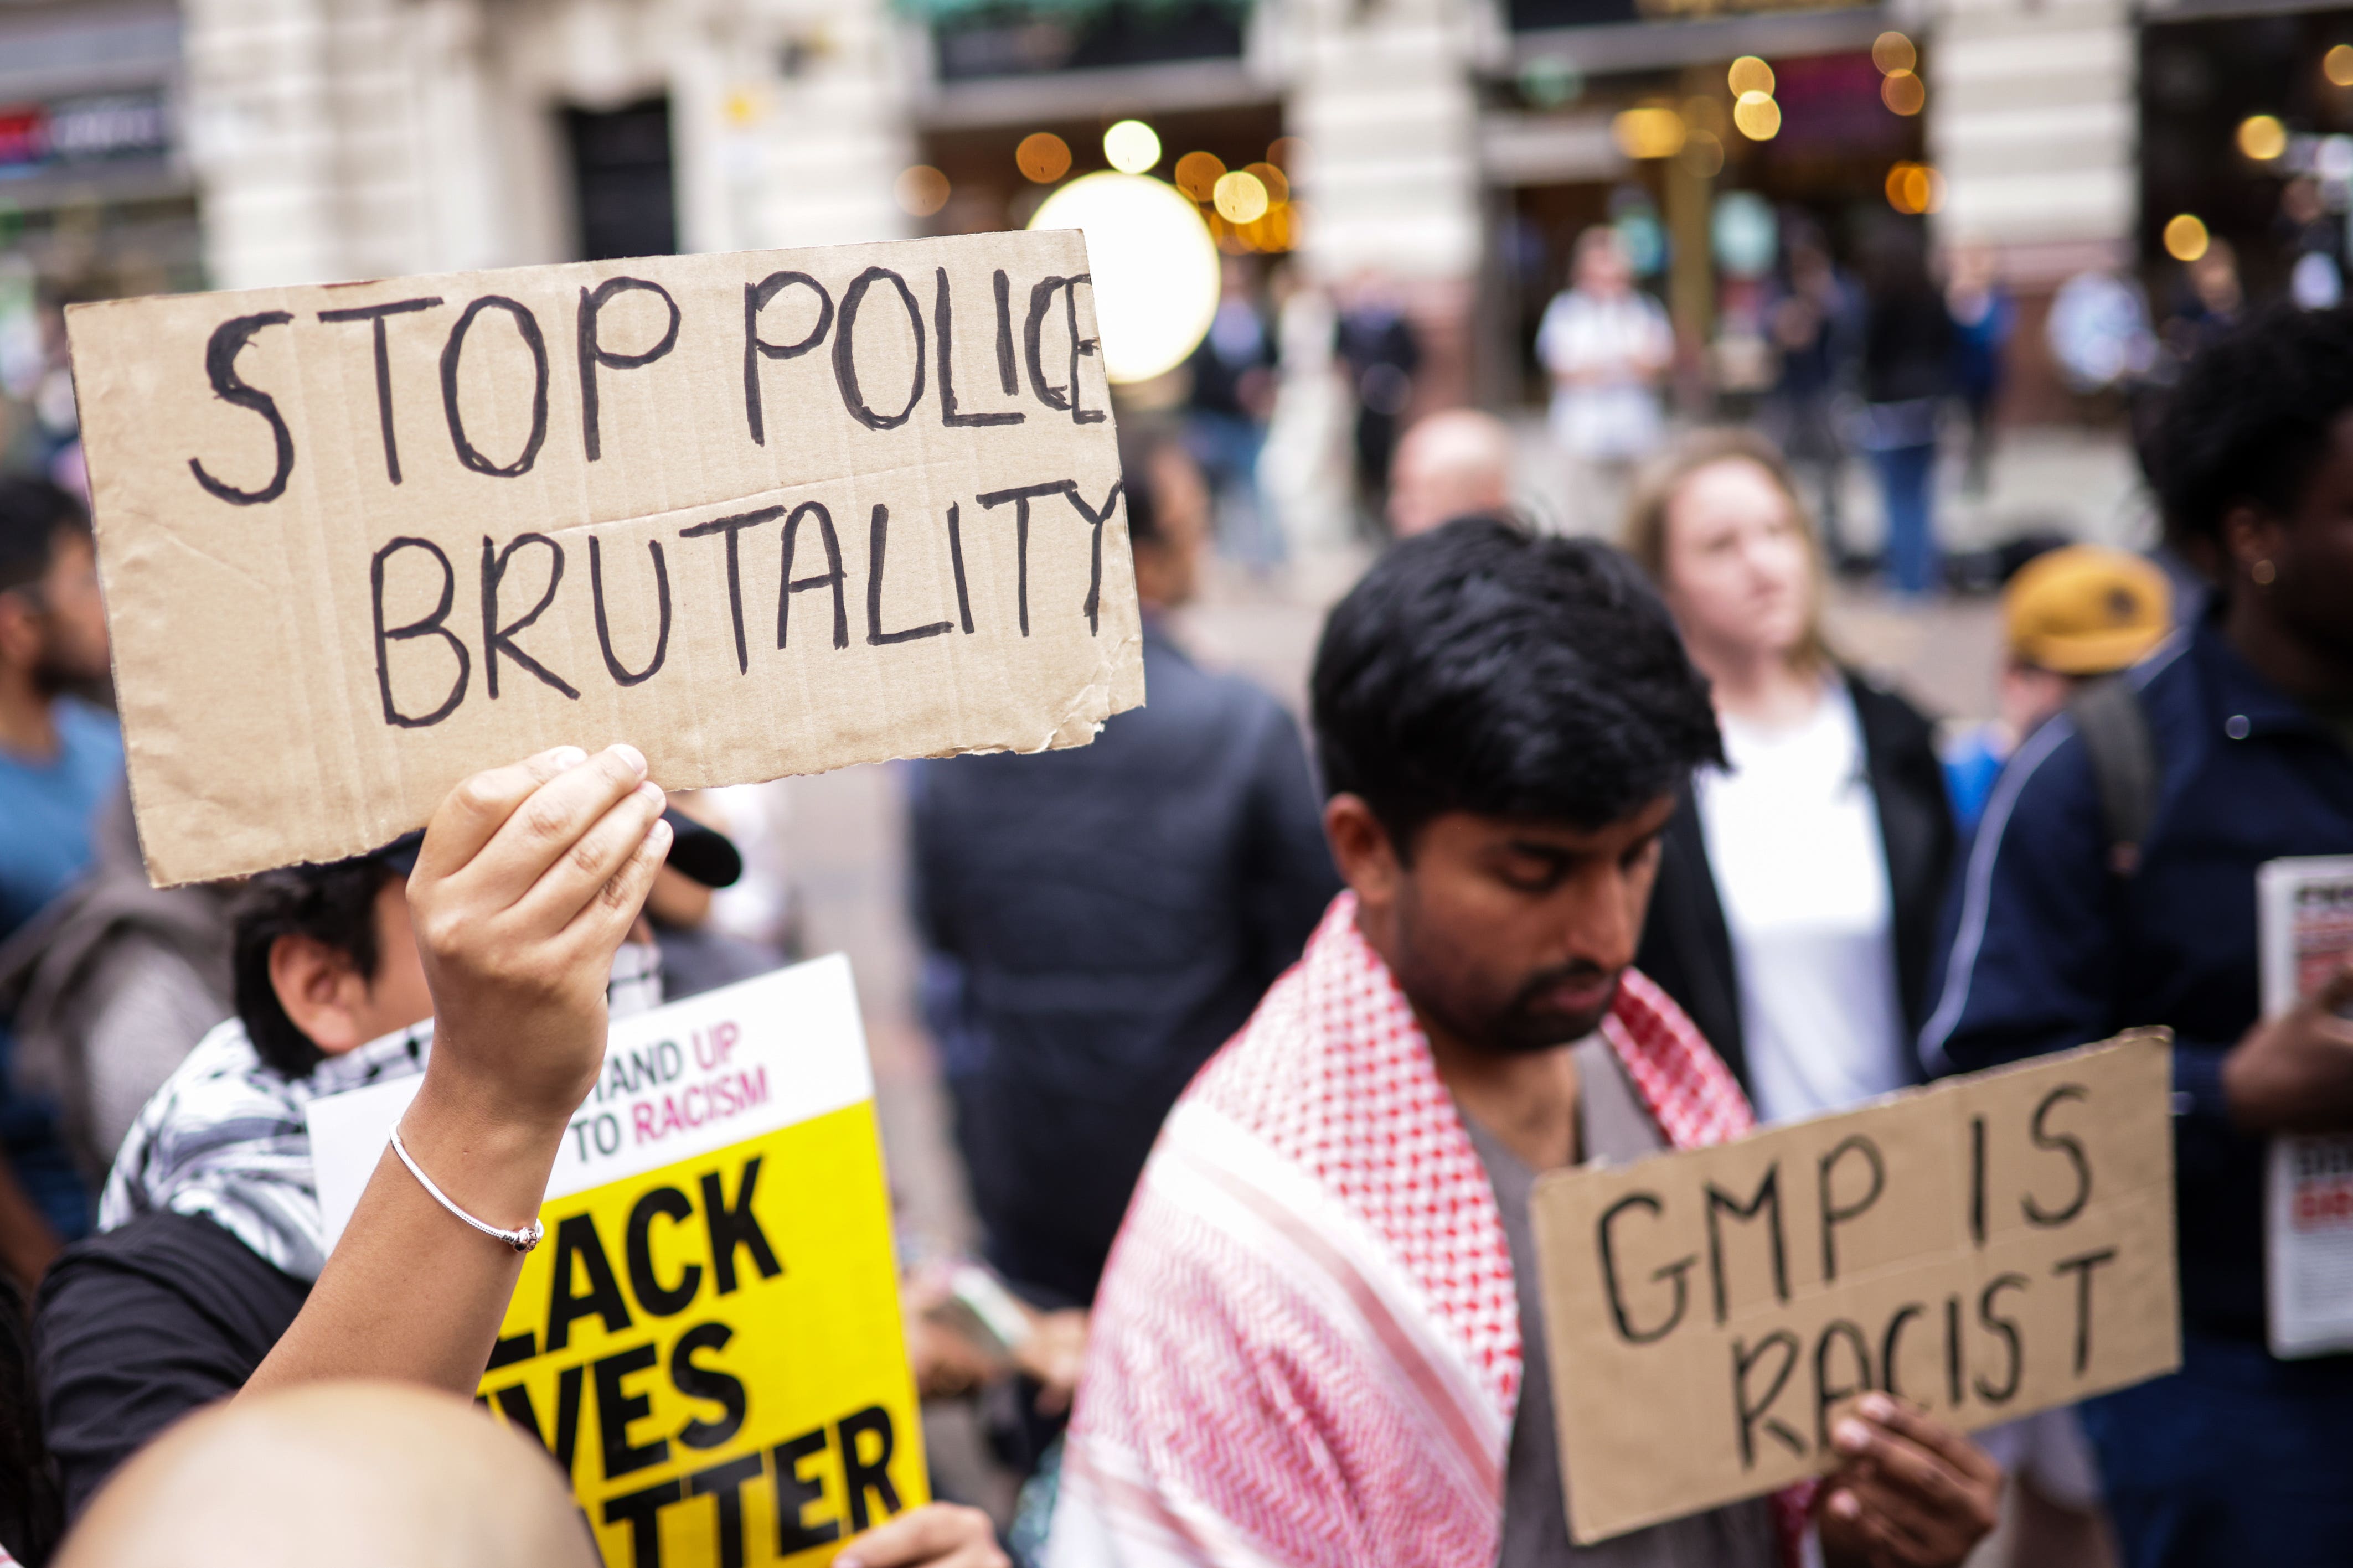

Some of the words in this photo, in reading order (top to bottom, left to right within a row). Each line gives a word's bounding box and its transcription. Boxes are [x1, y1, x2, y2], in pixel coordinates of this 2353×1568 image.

[189, 276, 683, 506] STOP
[743, 266, 1106, 446] POLICE
[370, 479, 1123, 728] BRUTALITY
[569, 1112, 621, 1163] TO
[632, 1063, 772, 1147] RACISM
[577, 1039, 684, 1112] TAND
[690, 1020, 741, 1073] UP
[483, 1154, 783, 1372] ACK
[1596, 1134, 1885, 1343] GMP
[1969, 1083, 2093, 1251] IS
[474, 1320, 749, 1489] VES
[1731, 1245, 2119, 1474] RACIST
[601, 1404, 902, 1568] TTER
